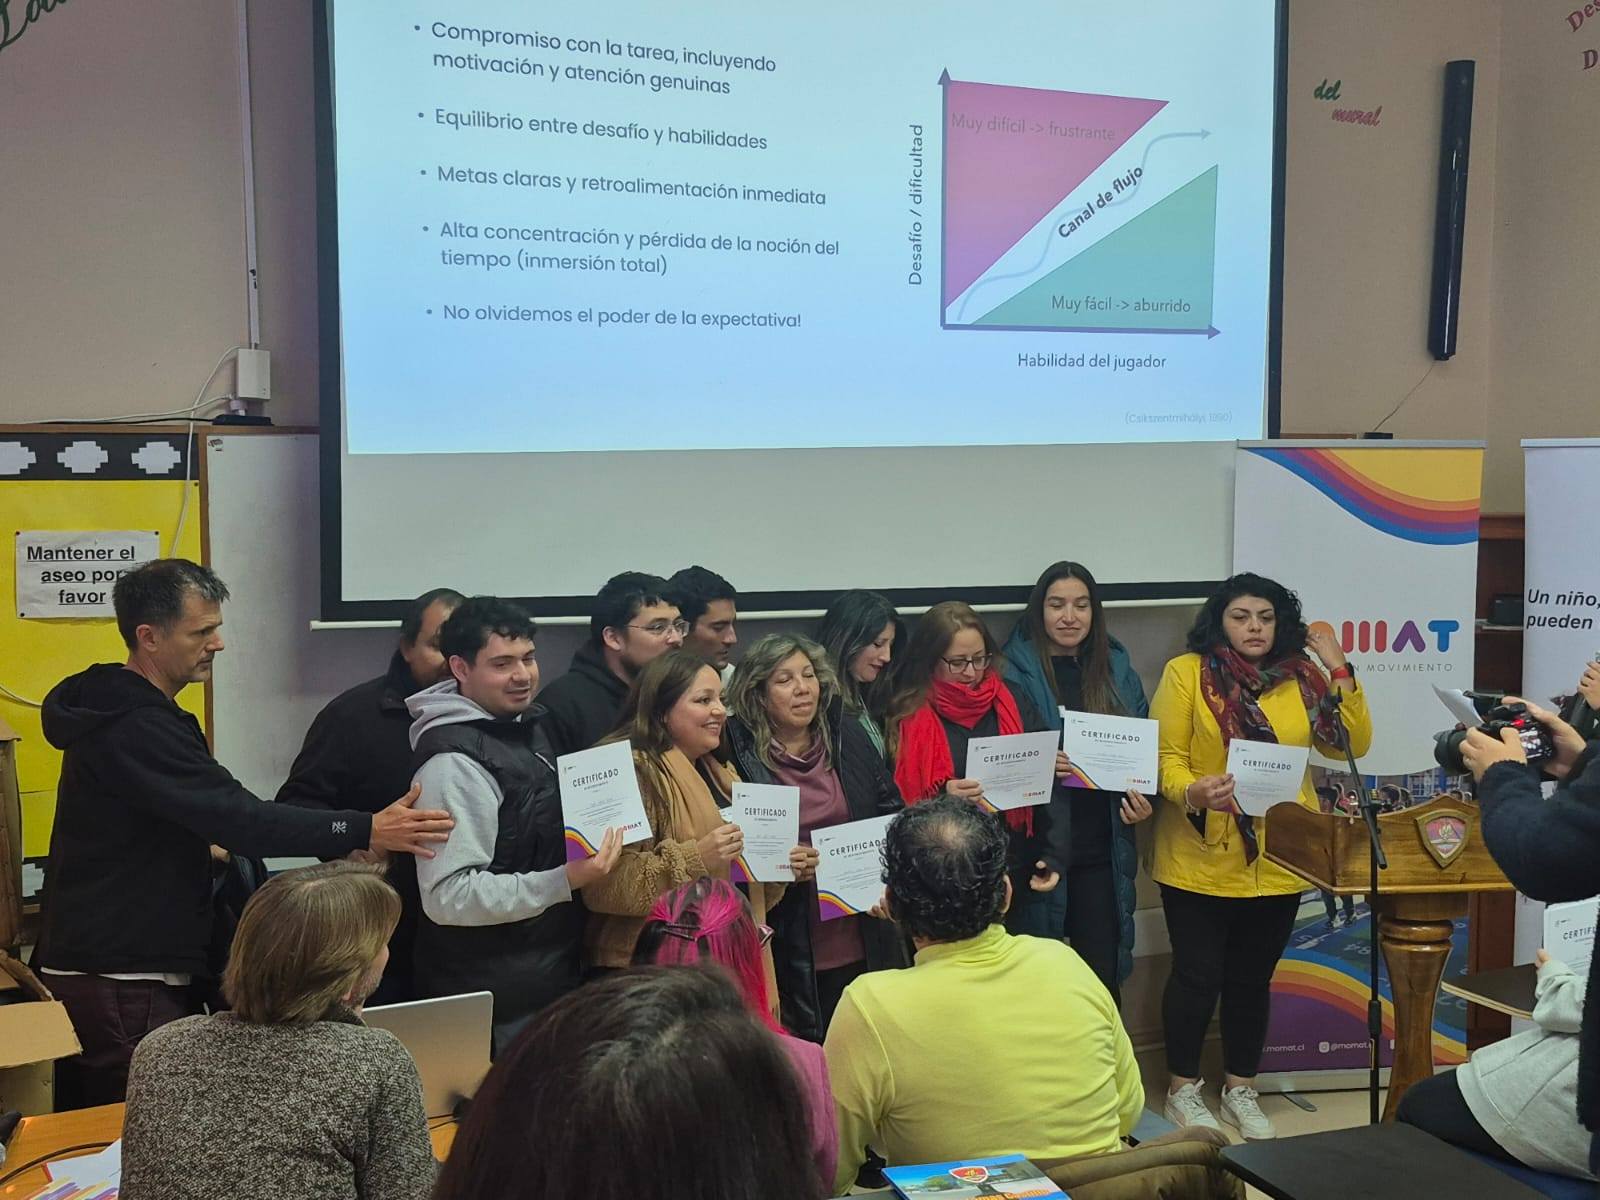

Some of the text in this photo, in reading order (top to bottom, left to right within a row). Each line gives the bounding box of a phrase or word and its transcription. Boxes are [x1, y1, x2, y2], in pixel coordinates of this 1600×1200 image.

[432, 22, 776, 72] Compromiso con la tarea, incluyendo
[433, 53, 730, 94] motivación y atención genuinas
[1314, 79, 1342, 101] del
[1332, 105, 1383, 127] mural
[435, 108, 767, 150] Equilibrio entre desafío y habilidades
[951, 112, 983, 135] Muy
[987, 117, 1026, 135] difícil
[1048, 121, 1115, 141] frustrante
[908, 124, 923, 206] dificultad
[437, 166, 826, 205] Metas claras y retroalimentación inmediata
[1058, 165, 1144, 239] Canal de flujo
[440, 222, 839, 255] Alta concentración y pérdida de la noción del
[441, 248, 667, 276] tiempo (inmersión total)
[908, 223, 923, 285] Desafío
[1052, 296, 1081, 312] Muy
[1085, 296, 1112, 311] fácil
[1134, 299, 1191, 313] aburrido
[443, 305, 801, 330] No olvidemos el poder de la expectativa!
[1018, 354, 1167, 371] Habilidad del jugador
[27, 546, 135, 560] Mantener el
[41, 570, 121, 584] aseo por
[59, 590, 106, 603] favor
[1528, 589, 1550, 604] Un
[1526, 614, 1593, 629] pueden
[1366, 663, 1453, 672] MOVIMIENTO
[1081, 730, 1140, 742] CERTIFICADO
[984, 750, 1039, 762] CERTIFICADO
[1243, 760, 1292, 770] CERTIFICADO
[573, 768, 619, 787] CERTIFICADO
[744, 807, 787, 817] CERTIFICADO
